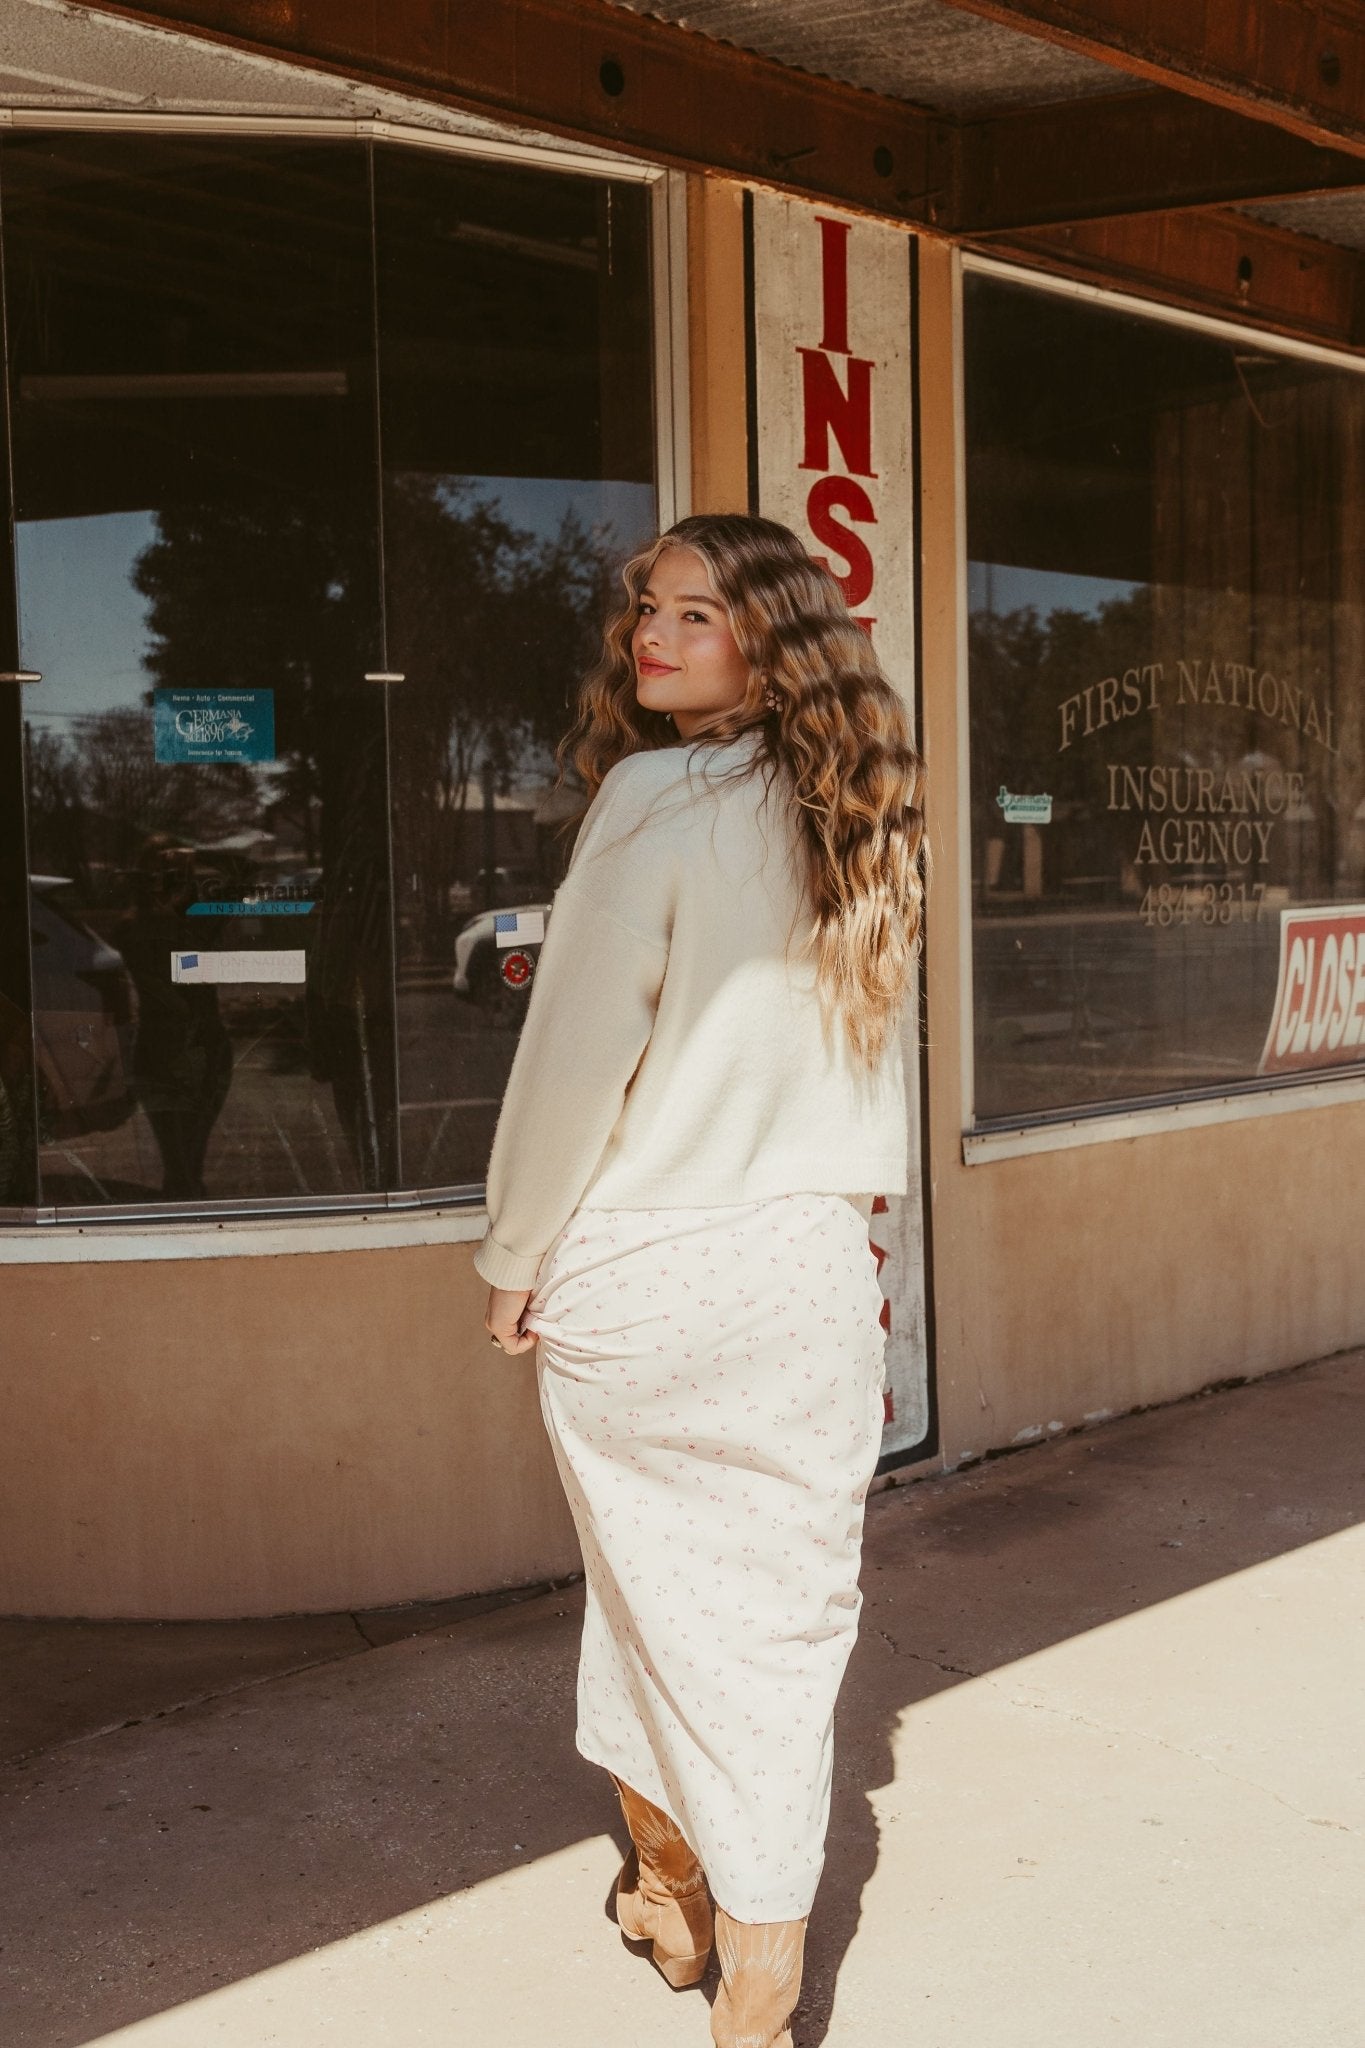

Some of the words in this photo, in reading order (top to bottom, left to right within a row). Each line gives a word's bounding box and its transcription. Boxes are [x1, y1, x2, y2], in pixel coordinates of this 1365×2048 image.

[795, 216, 881, 641] INS
[196, 694, 211, 702] Auto
[217, 694, 255, 702] Commercial
[1057, 662, 1164, 753] FIRST
[1177, 659, 1341, 755] NATIONAL
[175, 709, 242, 736] GERMANIA
[201, 721, 225, 744] 1896
[1106, 764, 1304, 818] INSURANCE
[1133, 818, 1275, 865] AGENCY
[208, 903, 302, 914] INSURANCE
[220, 956, 250, 967] ONE
[252, 956, 302, 967] NATION
[1275, 931, 1365, 1058] CLOSE
